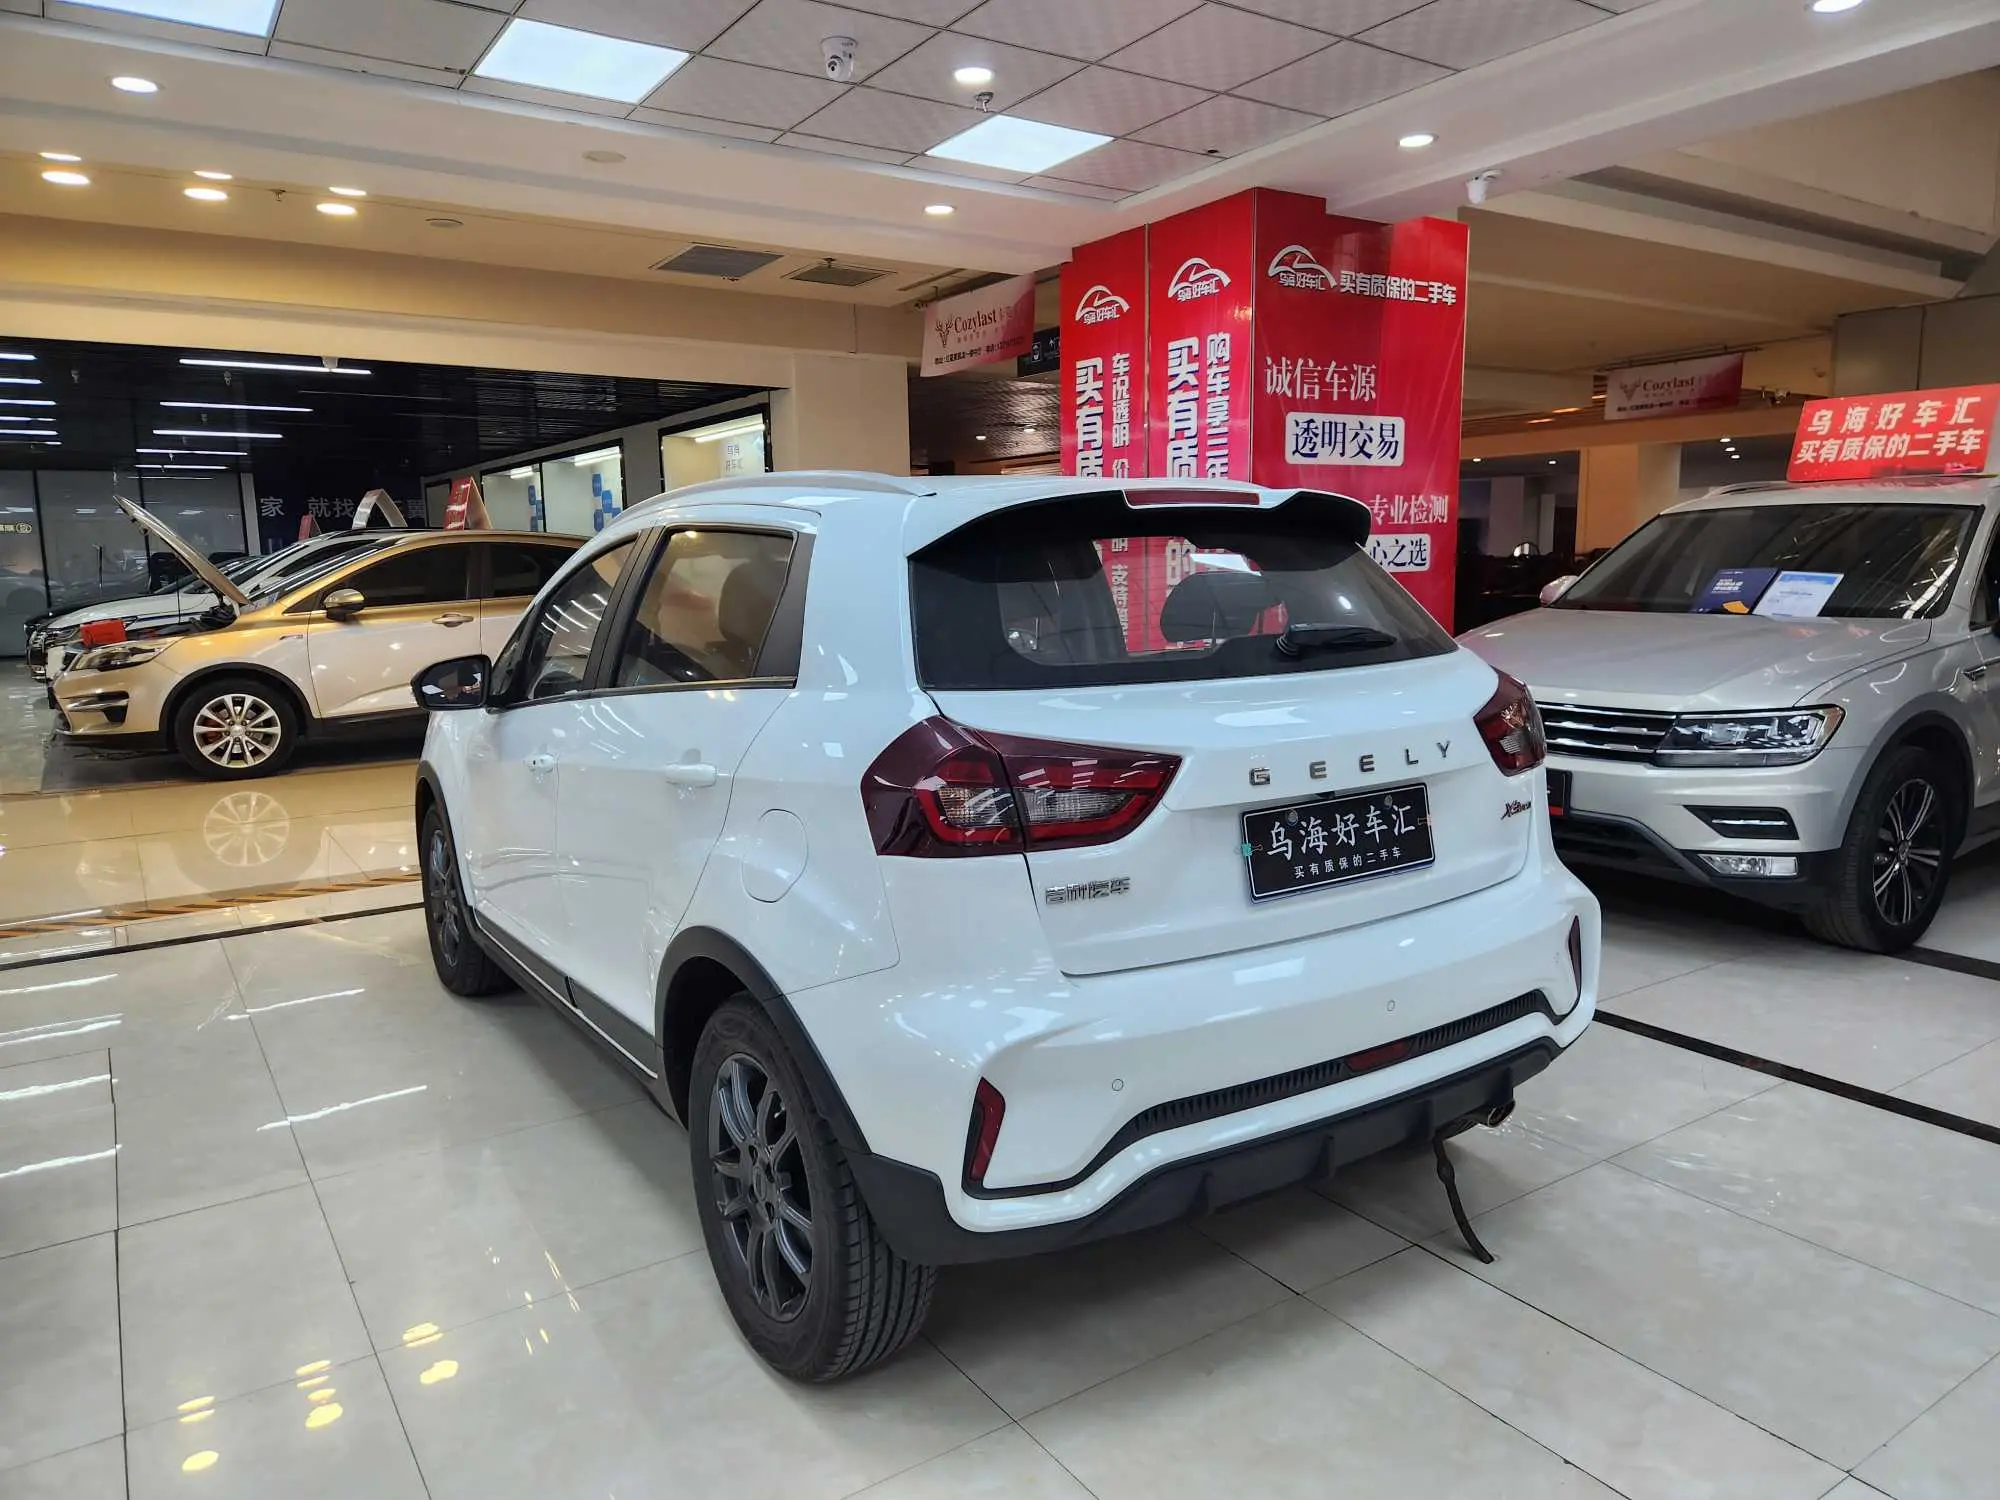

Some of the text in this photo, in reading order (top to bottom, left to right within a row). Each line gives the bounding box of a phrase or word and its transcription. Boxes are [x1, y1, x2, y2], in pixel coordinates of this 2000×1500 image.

[1340, 270, 1457, 305] 买有质保的二手车
[954, 309, 997, 333] Cozylast
[1264, 356, 1377, 401] 诚信车源
[1642, 375, 1696, 393] Cozylast
[1808, 396, 1981, 435] 乌海好车汇
[1292, 418, 1399, 460] 透明交易
[1794, 428, 1985, 465] 买有质保的二手车
[1369, 494, 1449, 526] 专业检测
[1249, 740, 1451, 786] GEELY
[1266, 804, 1416, 861] 乌海好车汇
[1294, 846, 1402, 880] 买有质保的二手车
